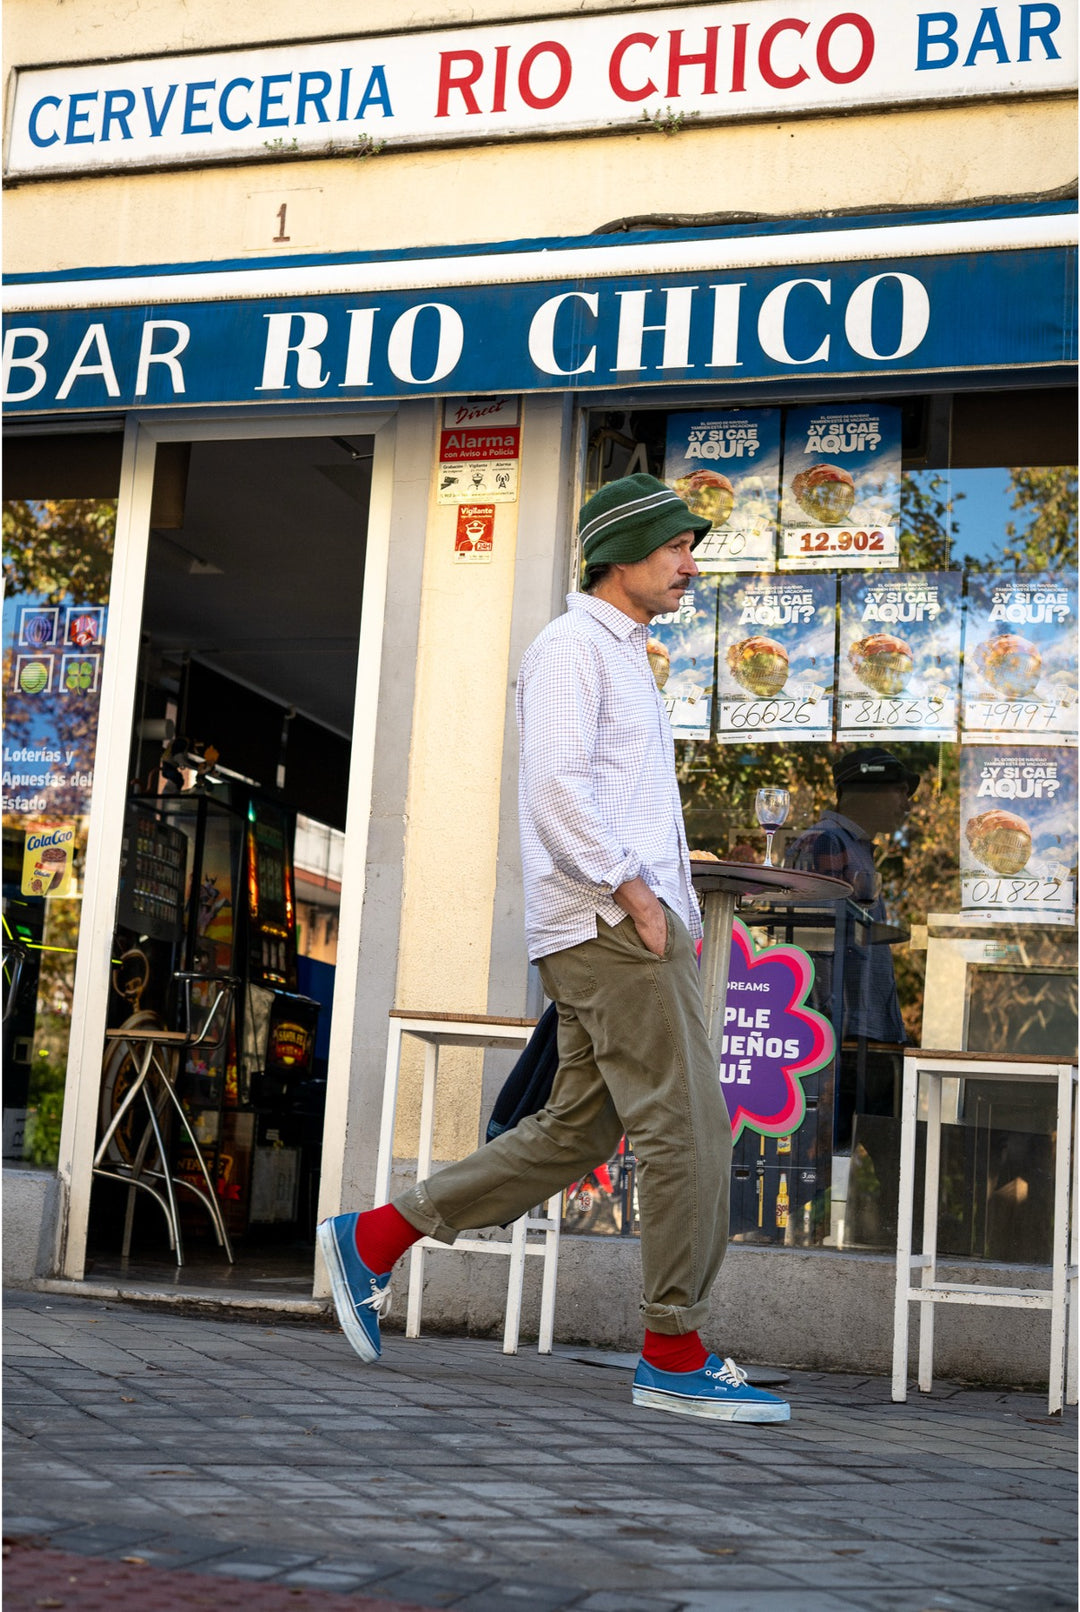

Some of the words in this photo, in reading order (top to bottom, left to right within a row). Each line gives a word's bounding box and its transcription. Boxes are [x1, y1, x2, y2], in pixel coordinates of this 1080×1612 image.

[28, 64, 395, 148] CERVECERIA
[434, 40, 572, 118] RIO
[608, 12, 875, 102] CHICO
[914, 2, 1063, 71] BAR
[272, 203, 291, 242] 1
[2, 319, 191, 401] BAR
[254, 301, 464, 390] RIO
[528, 272, 930, 376] CHICO
[455, 399, 510, 424] Direct
[688, 430, 707, 441] ¿Y
[709, 430, 723, 440] SI
[726, 429, 757, 440] CAE
[807, 424, 826, 436] ¿Y
[829, 424, 844, 434] SI
[846, 422, 879, 433] CAE
[445, 433, 515, 449] Alarma
[684, 440, 760, 460] AQUÍ?
[803, 433, 882, 454] AQUÍ?
[489, 448, 514, 456] Policía
[461, 507, 493, 516] Vigilante
[703, 533, 746, 555] 770
[800, 531, 885, 552] 12.902
[741, 596, 760, 607] ¿Y
[763, 595, 778, 606] SI
[781, 594, 813, 606] CAE
[864, 593, 884, 604] ¿Y
[886, 592, 902, 603] SI
[904, 591, 938, 603] CAE
[991, 592, 1012, 604] ¿Y
[1015, 592, 1030, 604] SI
[1033, 593, 1068, 604] CAE
[738, 605, 816, 626] AQUÍ?
[861, 603, 940, 624] AQUÍ?
[987, 603, 1071, 625] AQUÍ?
[981, 703, 1057, 728] 79997
[4, 747, 61, 762] Loterías
[65, 751, 73, 766] y
[2, 771, 66, 790] Apuestas
[70, 771, 92, 787] del
[980, 767, 1000, 778] ¿Y
[1003, 767, 1019, 778] SI
[1022, 766, 1057, 778] CAE
[976, 778, 1060, 800] AQUÍ?
[2, 795, 47, 811] Estado
[27, 830, 72, 851] ColaCao
[972, 880, 1061, 903] 01822
[724, 1006, 771, 1029] PLE
[721, 1031, 800, 1060] EÑOS
[719, 1059, 752, 1085] UÍ
